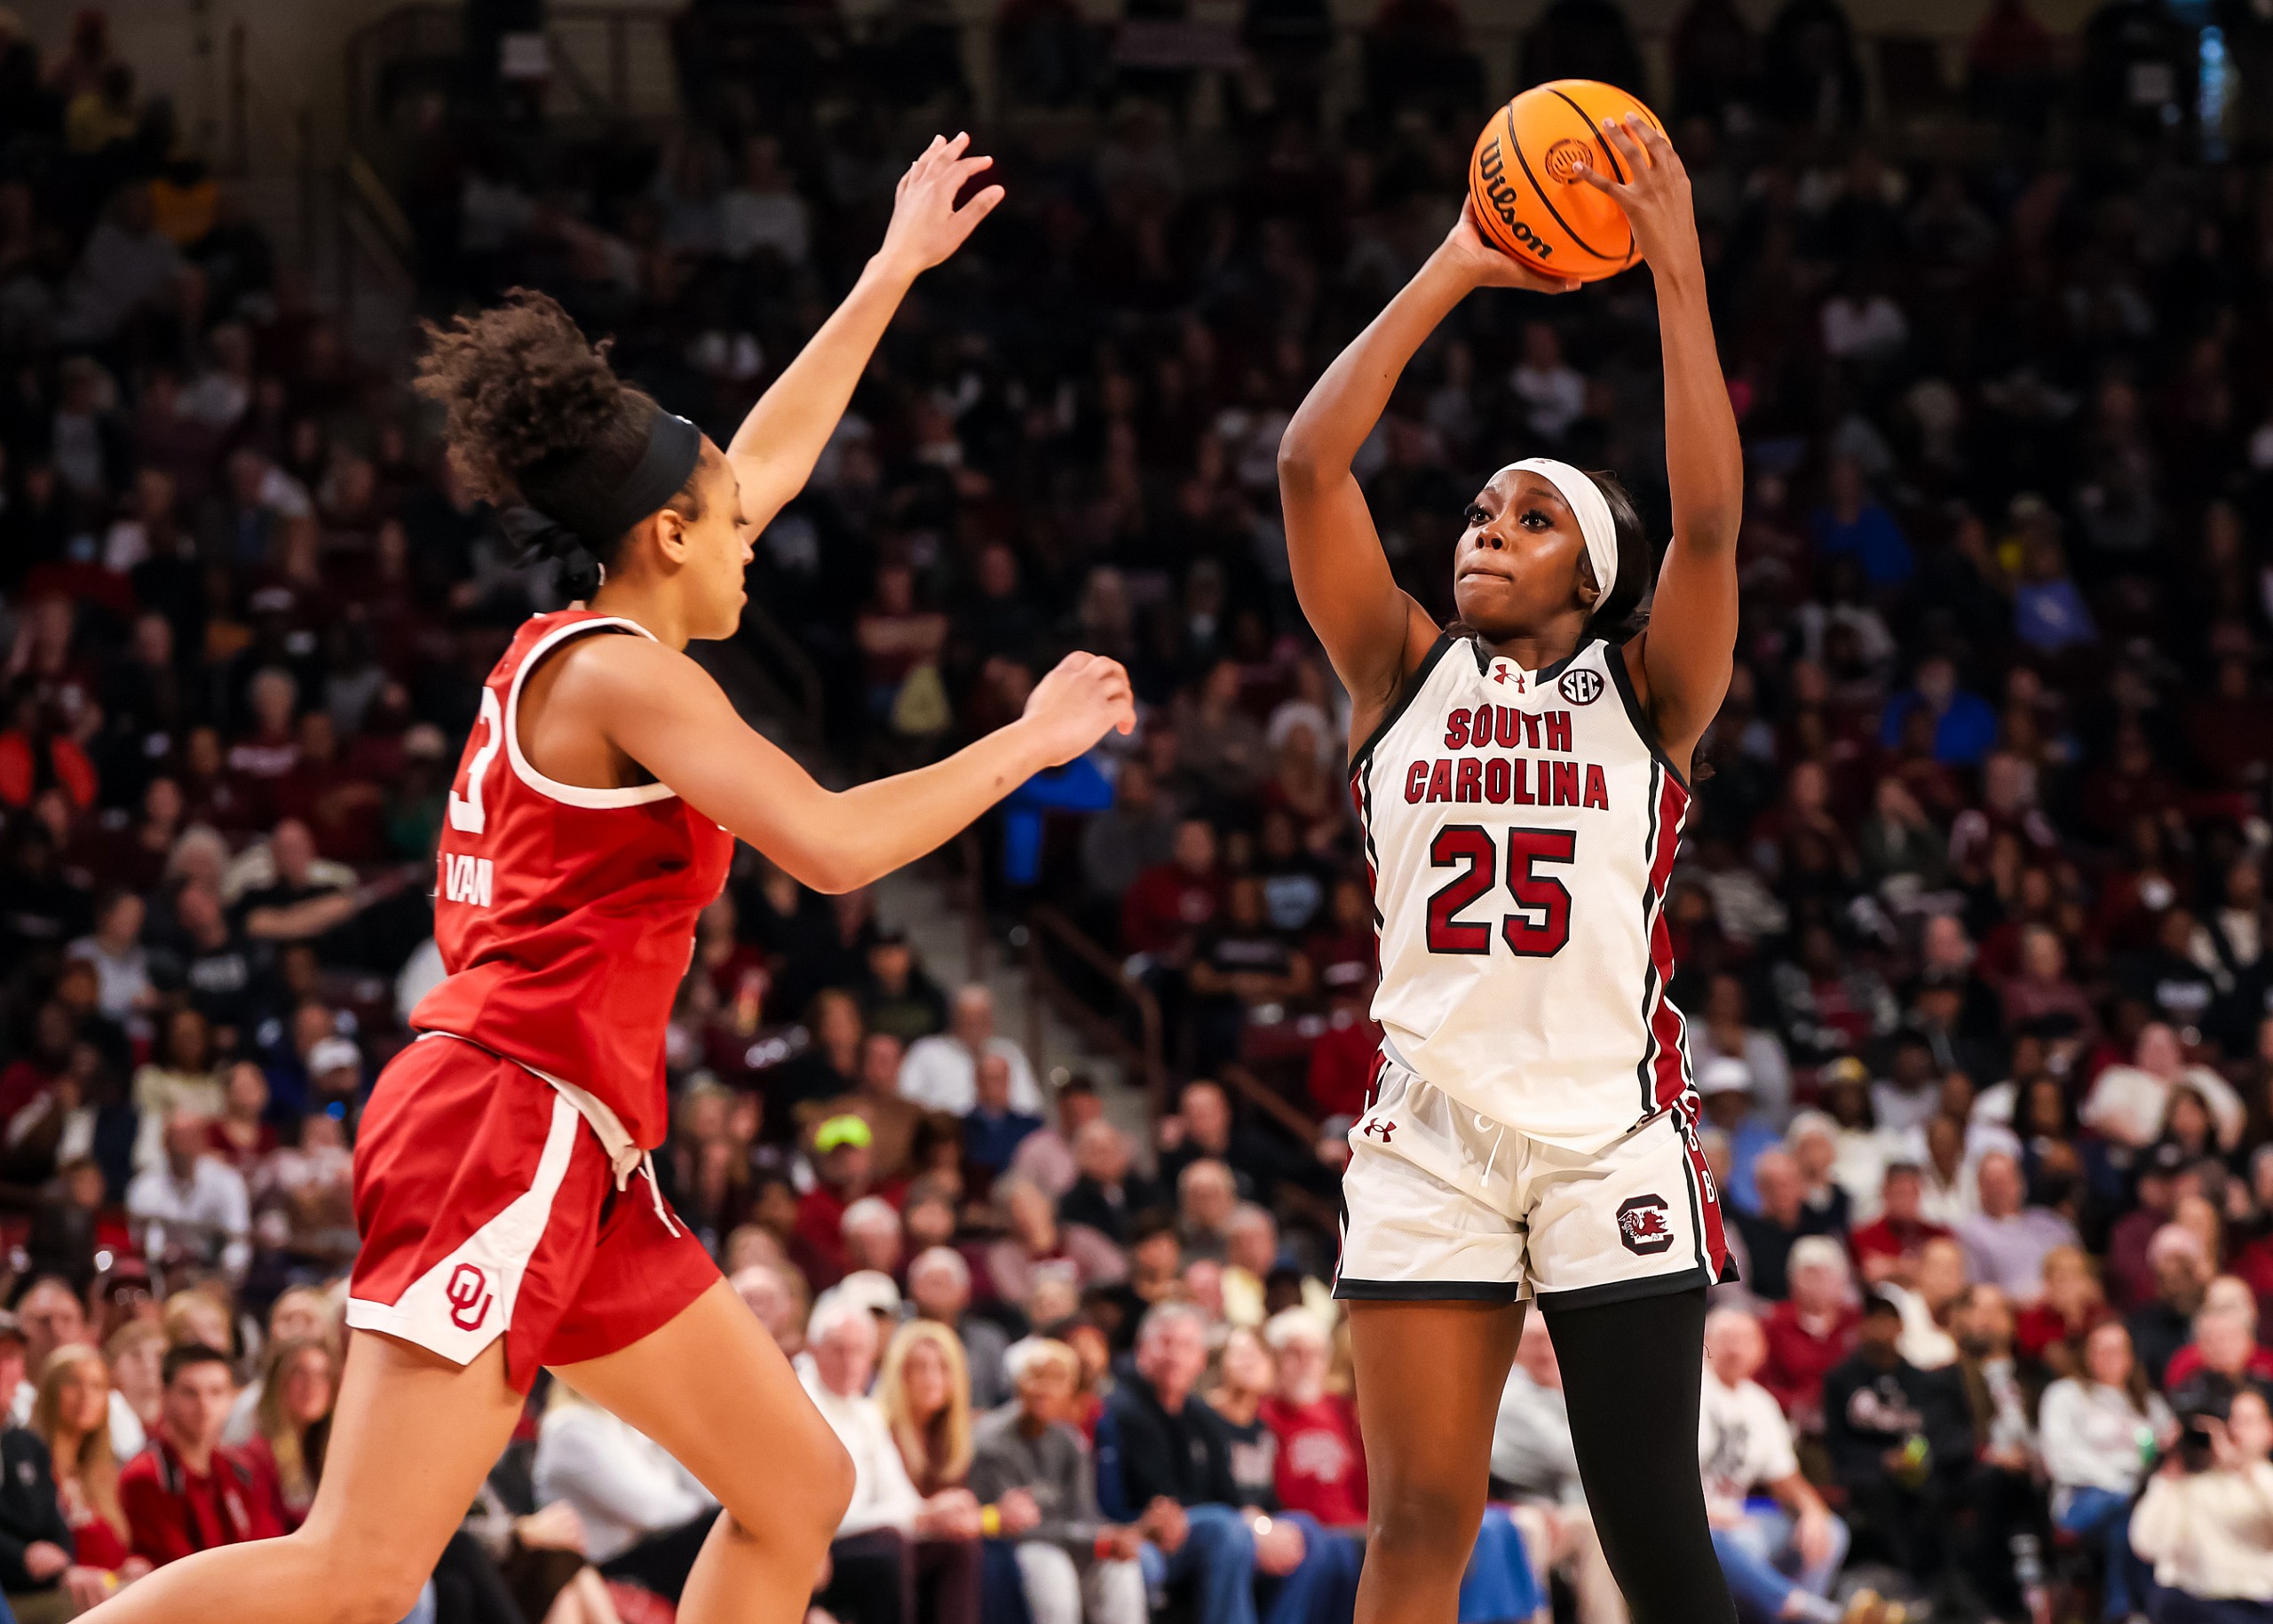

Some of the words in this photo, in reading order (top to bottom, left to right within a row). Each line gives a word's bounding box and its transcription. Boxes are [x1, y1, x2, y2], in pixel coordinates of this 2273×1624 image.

[1480, 134, 1554, 260] Wilson
[1562, 670, 1601, 703] SEC
[1444, 704, 1572, 752] SOUTH
[1404, 757, 1609, 811] CAROLINA
[435, 852, 494, 907] VAN
[1425, 824, 1577, 958] 25
[447, 1263, 493, 1332] OU
